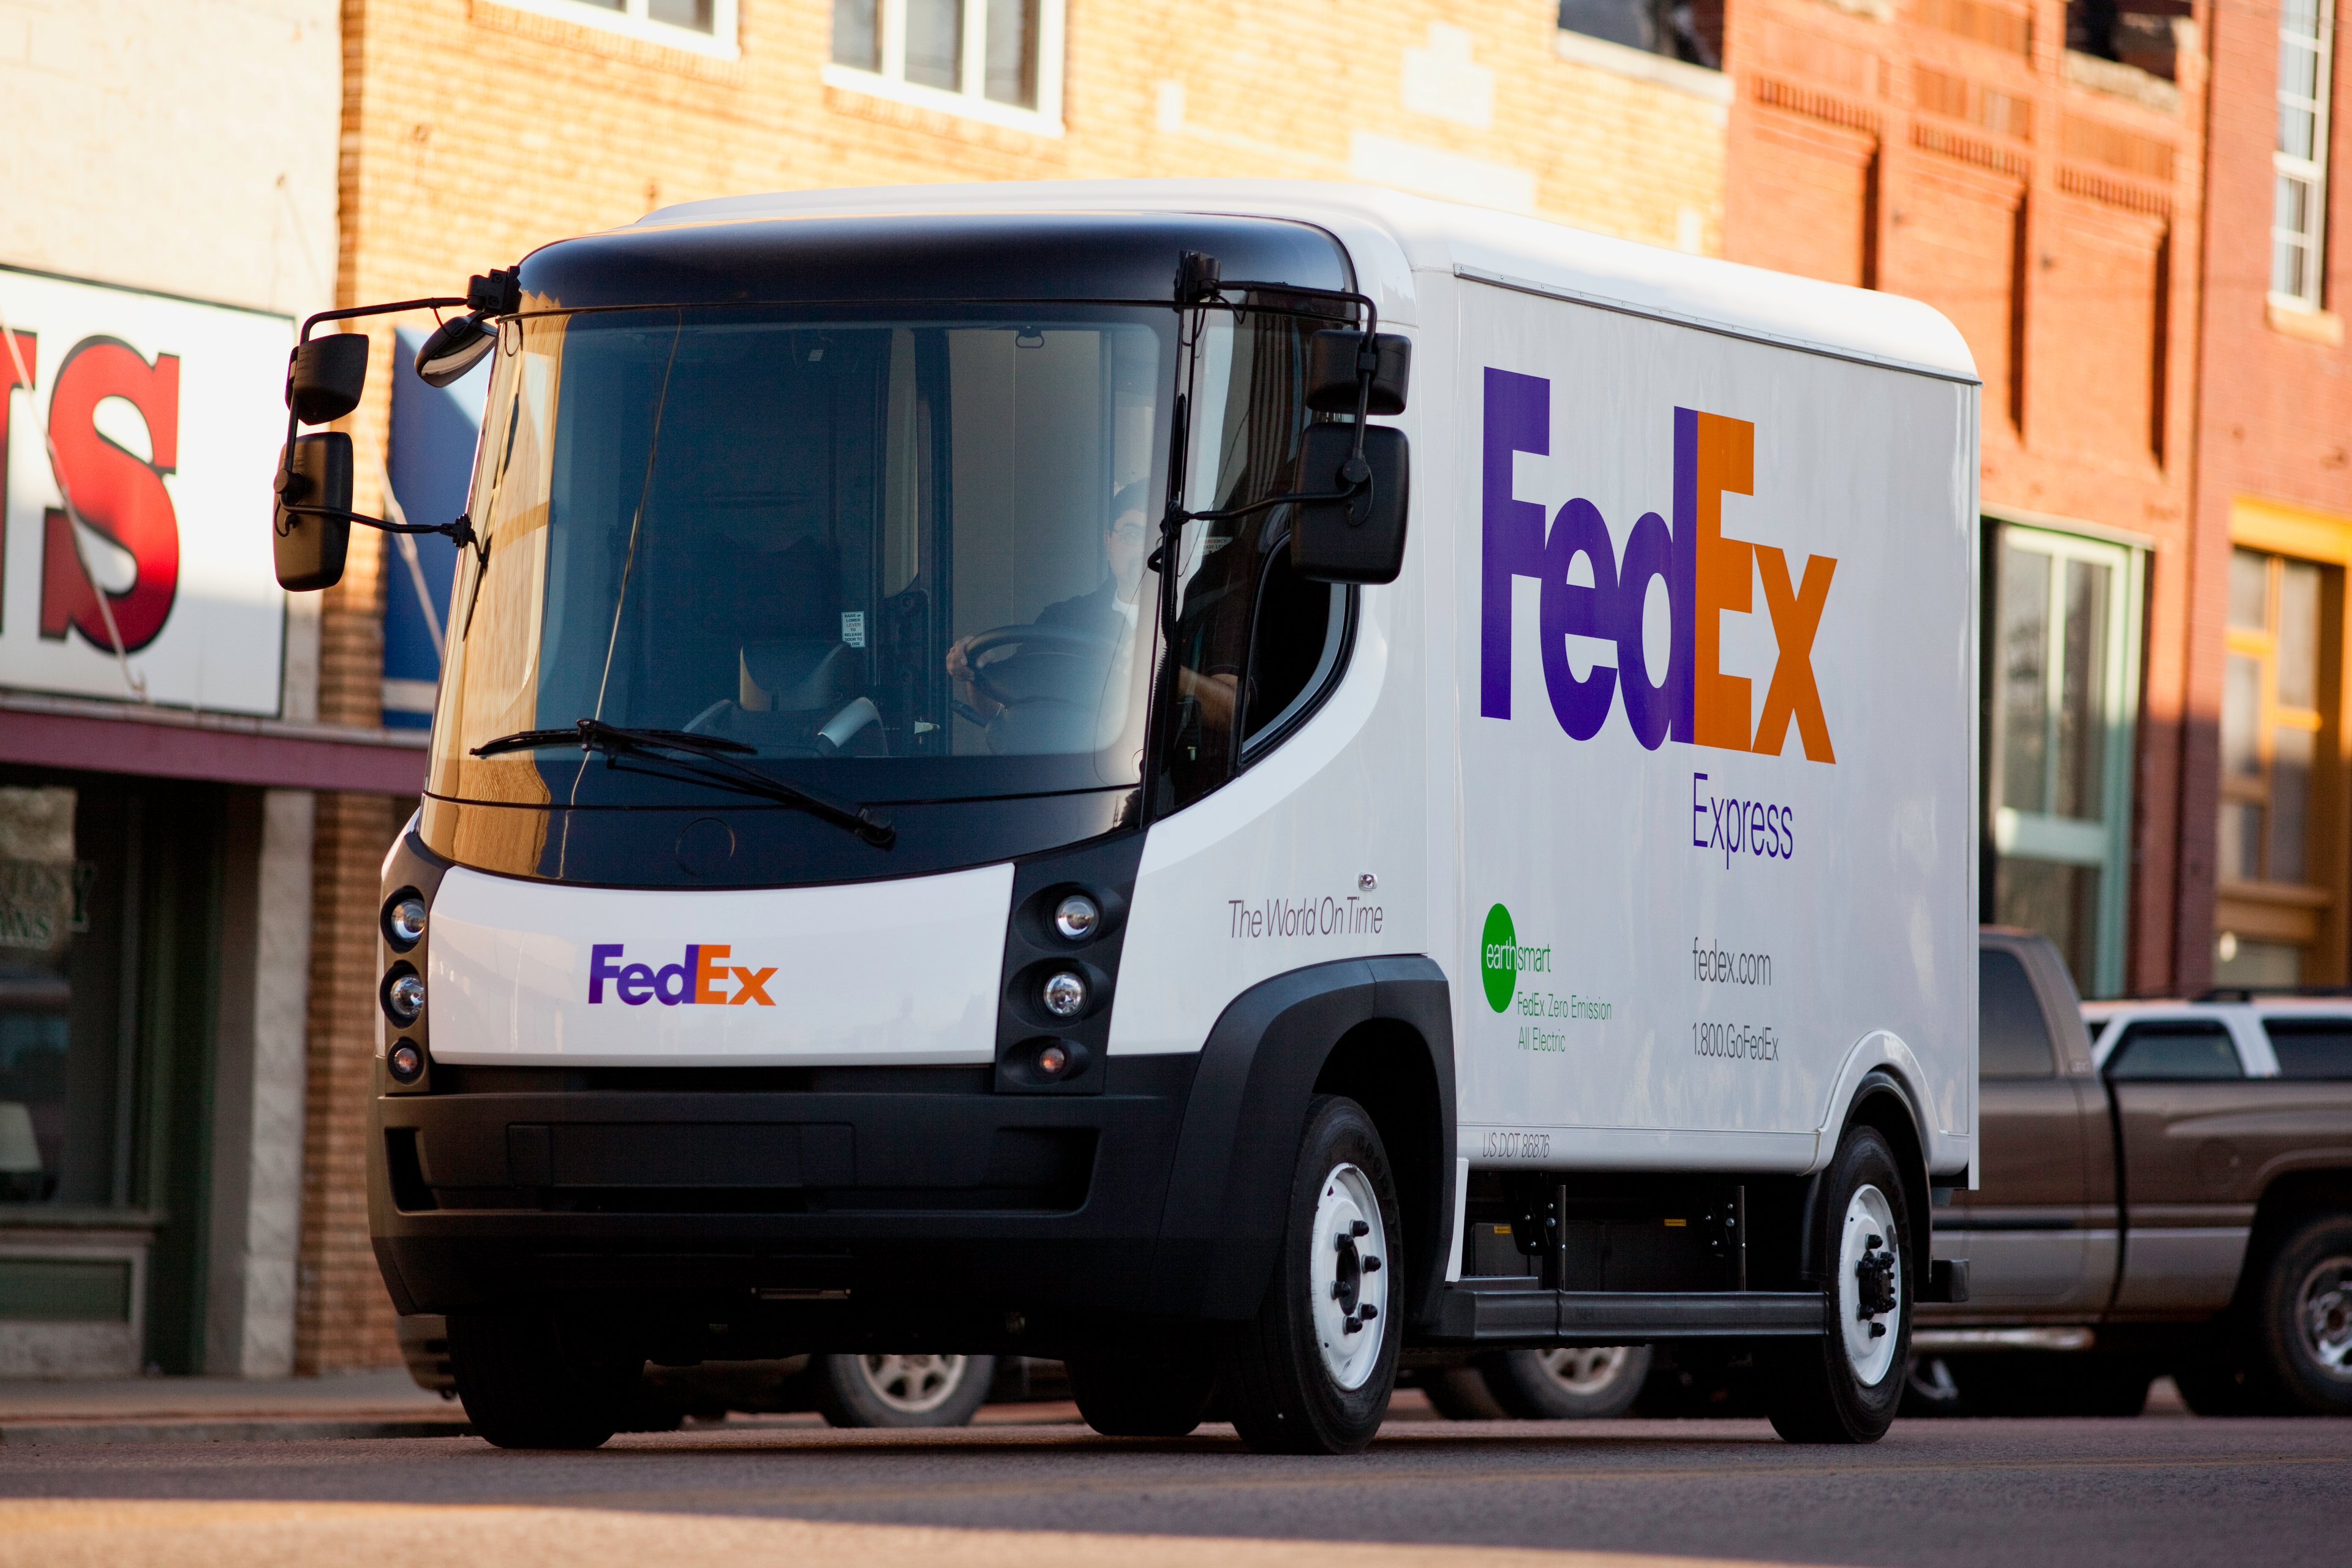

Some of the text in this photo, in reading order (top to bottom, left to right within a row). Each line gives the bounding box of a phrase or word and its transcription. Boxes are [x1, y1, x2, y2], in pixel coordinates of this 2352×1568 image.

[0, 325, 179, 657] S
[1480, 366, 1838, 764] FedEx
[1694, 772, 1793, 870] Express
[1229, 896, 1383, 938] The World On Time
[588, 944, 779, 1006] FedEx
[1692, 937, 1771, 986] fedex.com
[1517, 991, 1612, 1020] FedEx Zero Emission
[1518, 1026, 1566, 1052] All Electric
[1692, 1022, 1779, 1061] 1.800.GoFedEx
[1483, 1132, 1550, 1158] US DOT 86876
